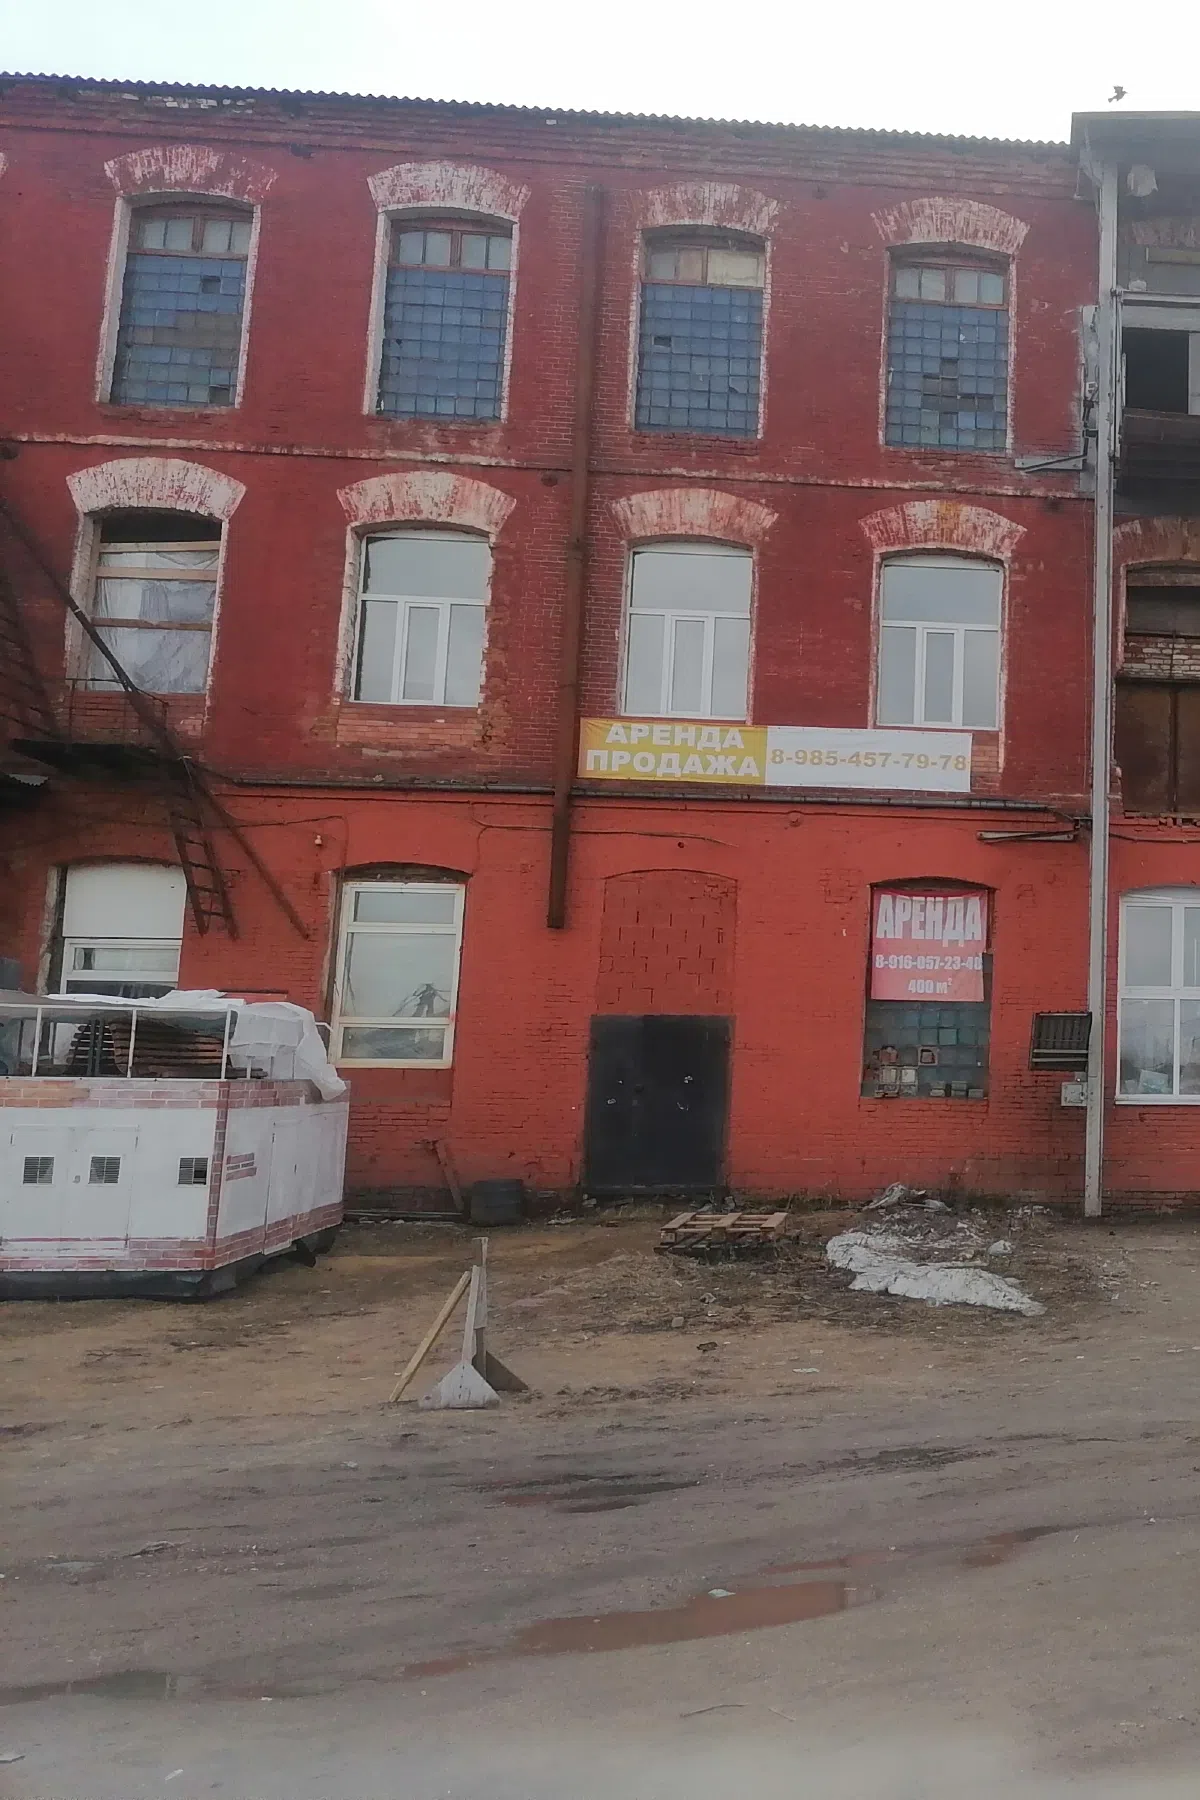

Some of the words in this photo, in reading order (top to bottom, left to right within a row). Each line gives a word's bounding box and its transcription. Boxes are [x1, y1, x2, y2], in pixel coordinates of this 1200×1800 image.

[605, 724, 745, 750] АРЕНДА
[586, 749, 760, 777] ПРОДАЖА
[771, 748, 967, 772] 8-985-457-79-78
[876, 894, 982, 947] АРЕНДА
[908, 979, 934, 994] 400
